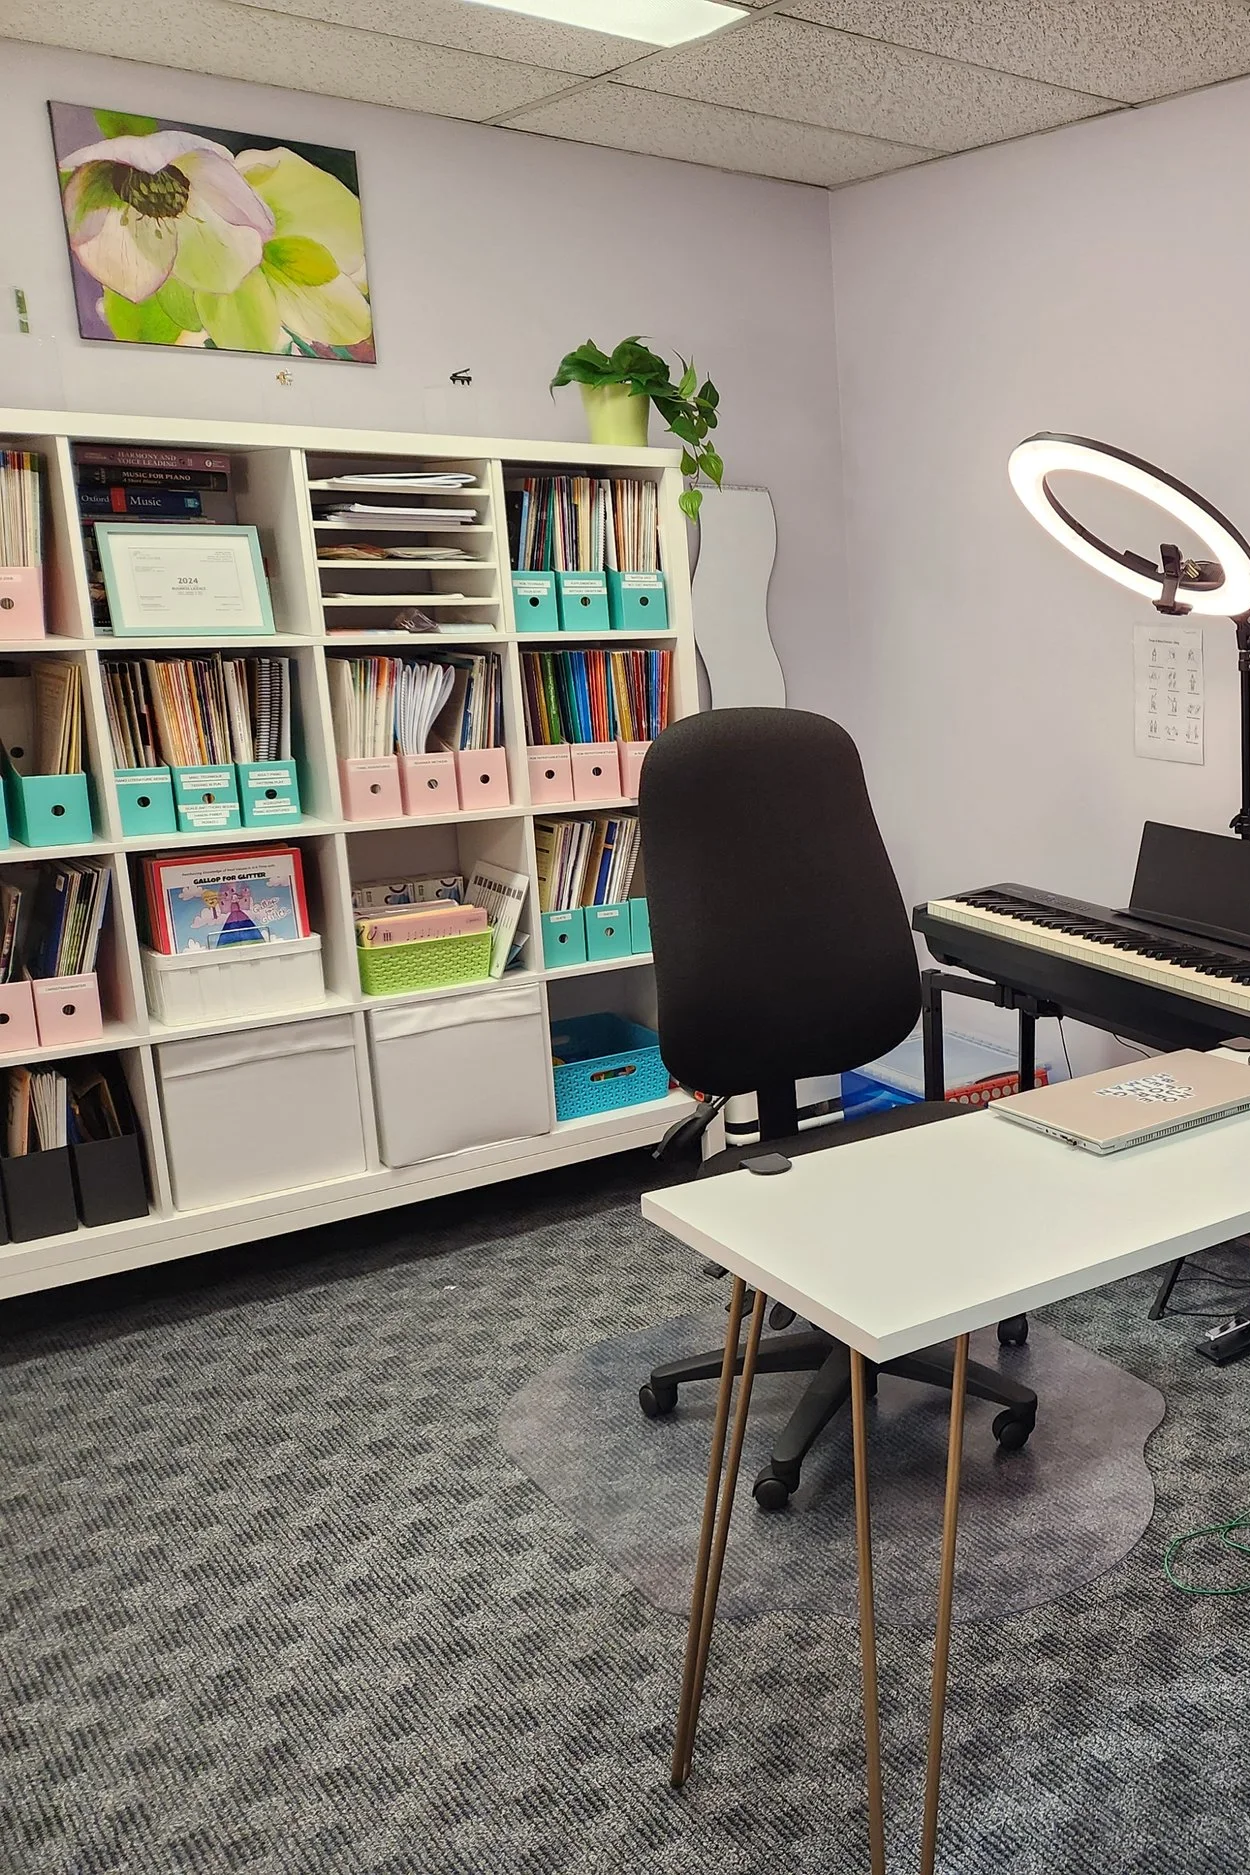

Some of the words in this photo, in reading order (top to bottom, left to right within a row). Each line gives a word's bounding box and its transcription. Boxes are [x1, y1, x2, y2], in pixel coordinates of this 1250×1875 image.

[118, 452, 158, 460] HARMONY
[142, 459, 178, 467] LEADING
[130, 496, 162, 506] Music
[1096, 1072, 1170, 1095] HUMAN
[1112, 1078, 1175, 1096] BEING
[1138, 1084, 1177, 1097] FOR
[1139, 1086, 1192, 1103] CURE
[1163, 1092, 1192, 1103] NO
